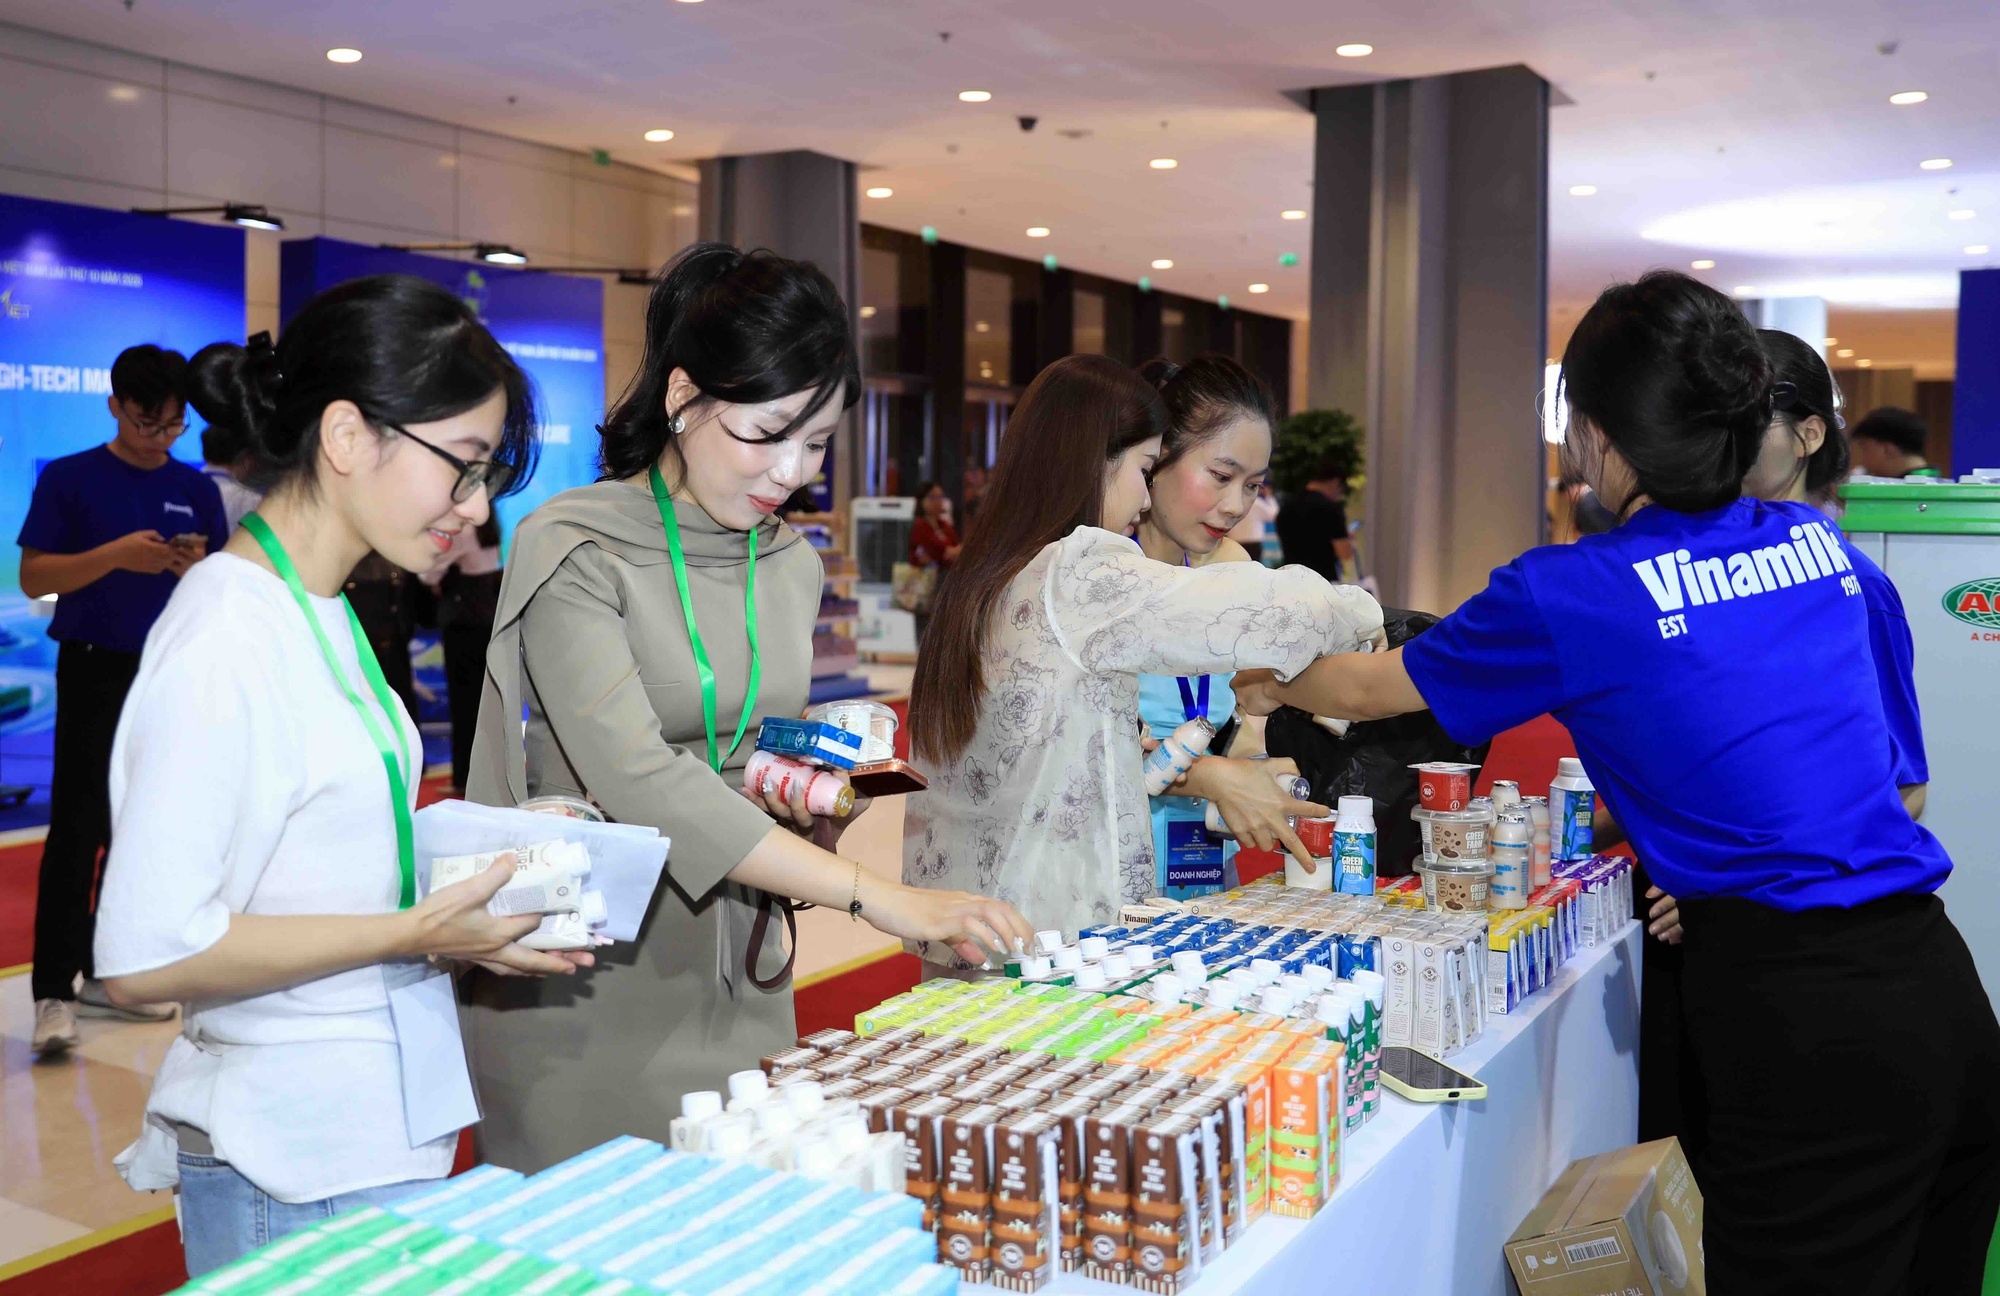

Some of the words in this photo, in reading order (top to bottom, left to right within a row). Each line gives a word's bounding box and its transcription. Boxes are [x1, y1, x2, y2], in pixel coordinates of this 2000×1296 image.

[1632, 520, 1853, 612] Vinamilk
[1955, 591, 2000, 614] A
[1657, 613, 1688, 639] EST
[1970, 632, 1979, 641] A
[1341, 856, 1363, 865] GREEN
[1169, 871, 1195, 880] DOANH
[1196, 868, 1221, 881] NGHIỆP
[1342, 865, 1363, 874] FARM
[1205, 885, 1220, 894] 588
